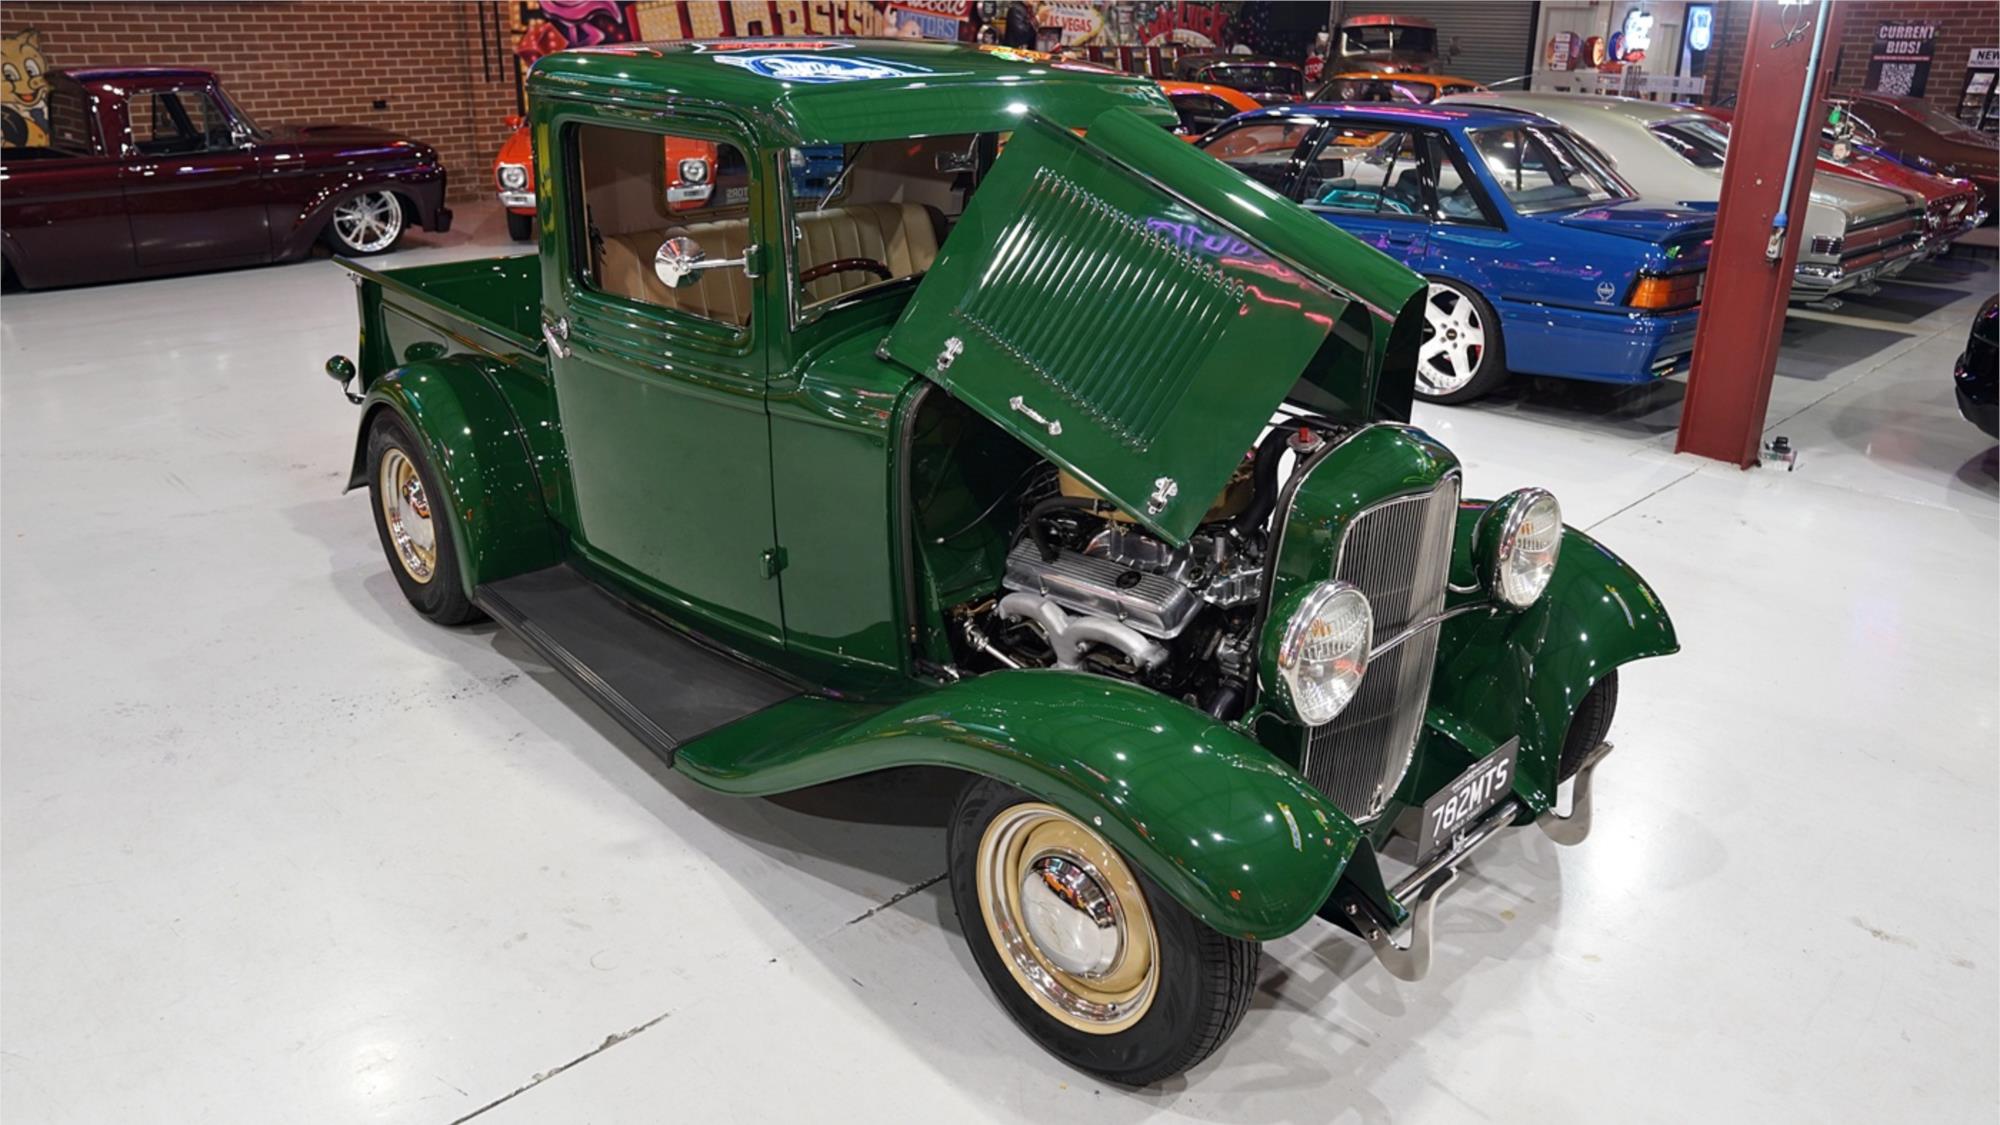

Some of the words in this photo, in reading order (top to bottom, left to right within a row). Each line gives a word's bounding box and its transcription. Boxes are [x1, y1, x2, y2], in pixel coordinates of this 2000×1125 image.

[1061, 17, 1092, 32] VEGAS
[1879, 25, 1935, 39] CURRENT
[1886, 41, 1921, 54] BIDS!
[1305, 63, 1324, 75] STOP
